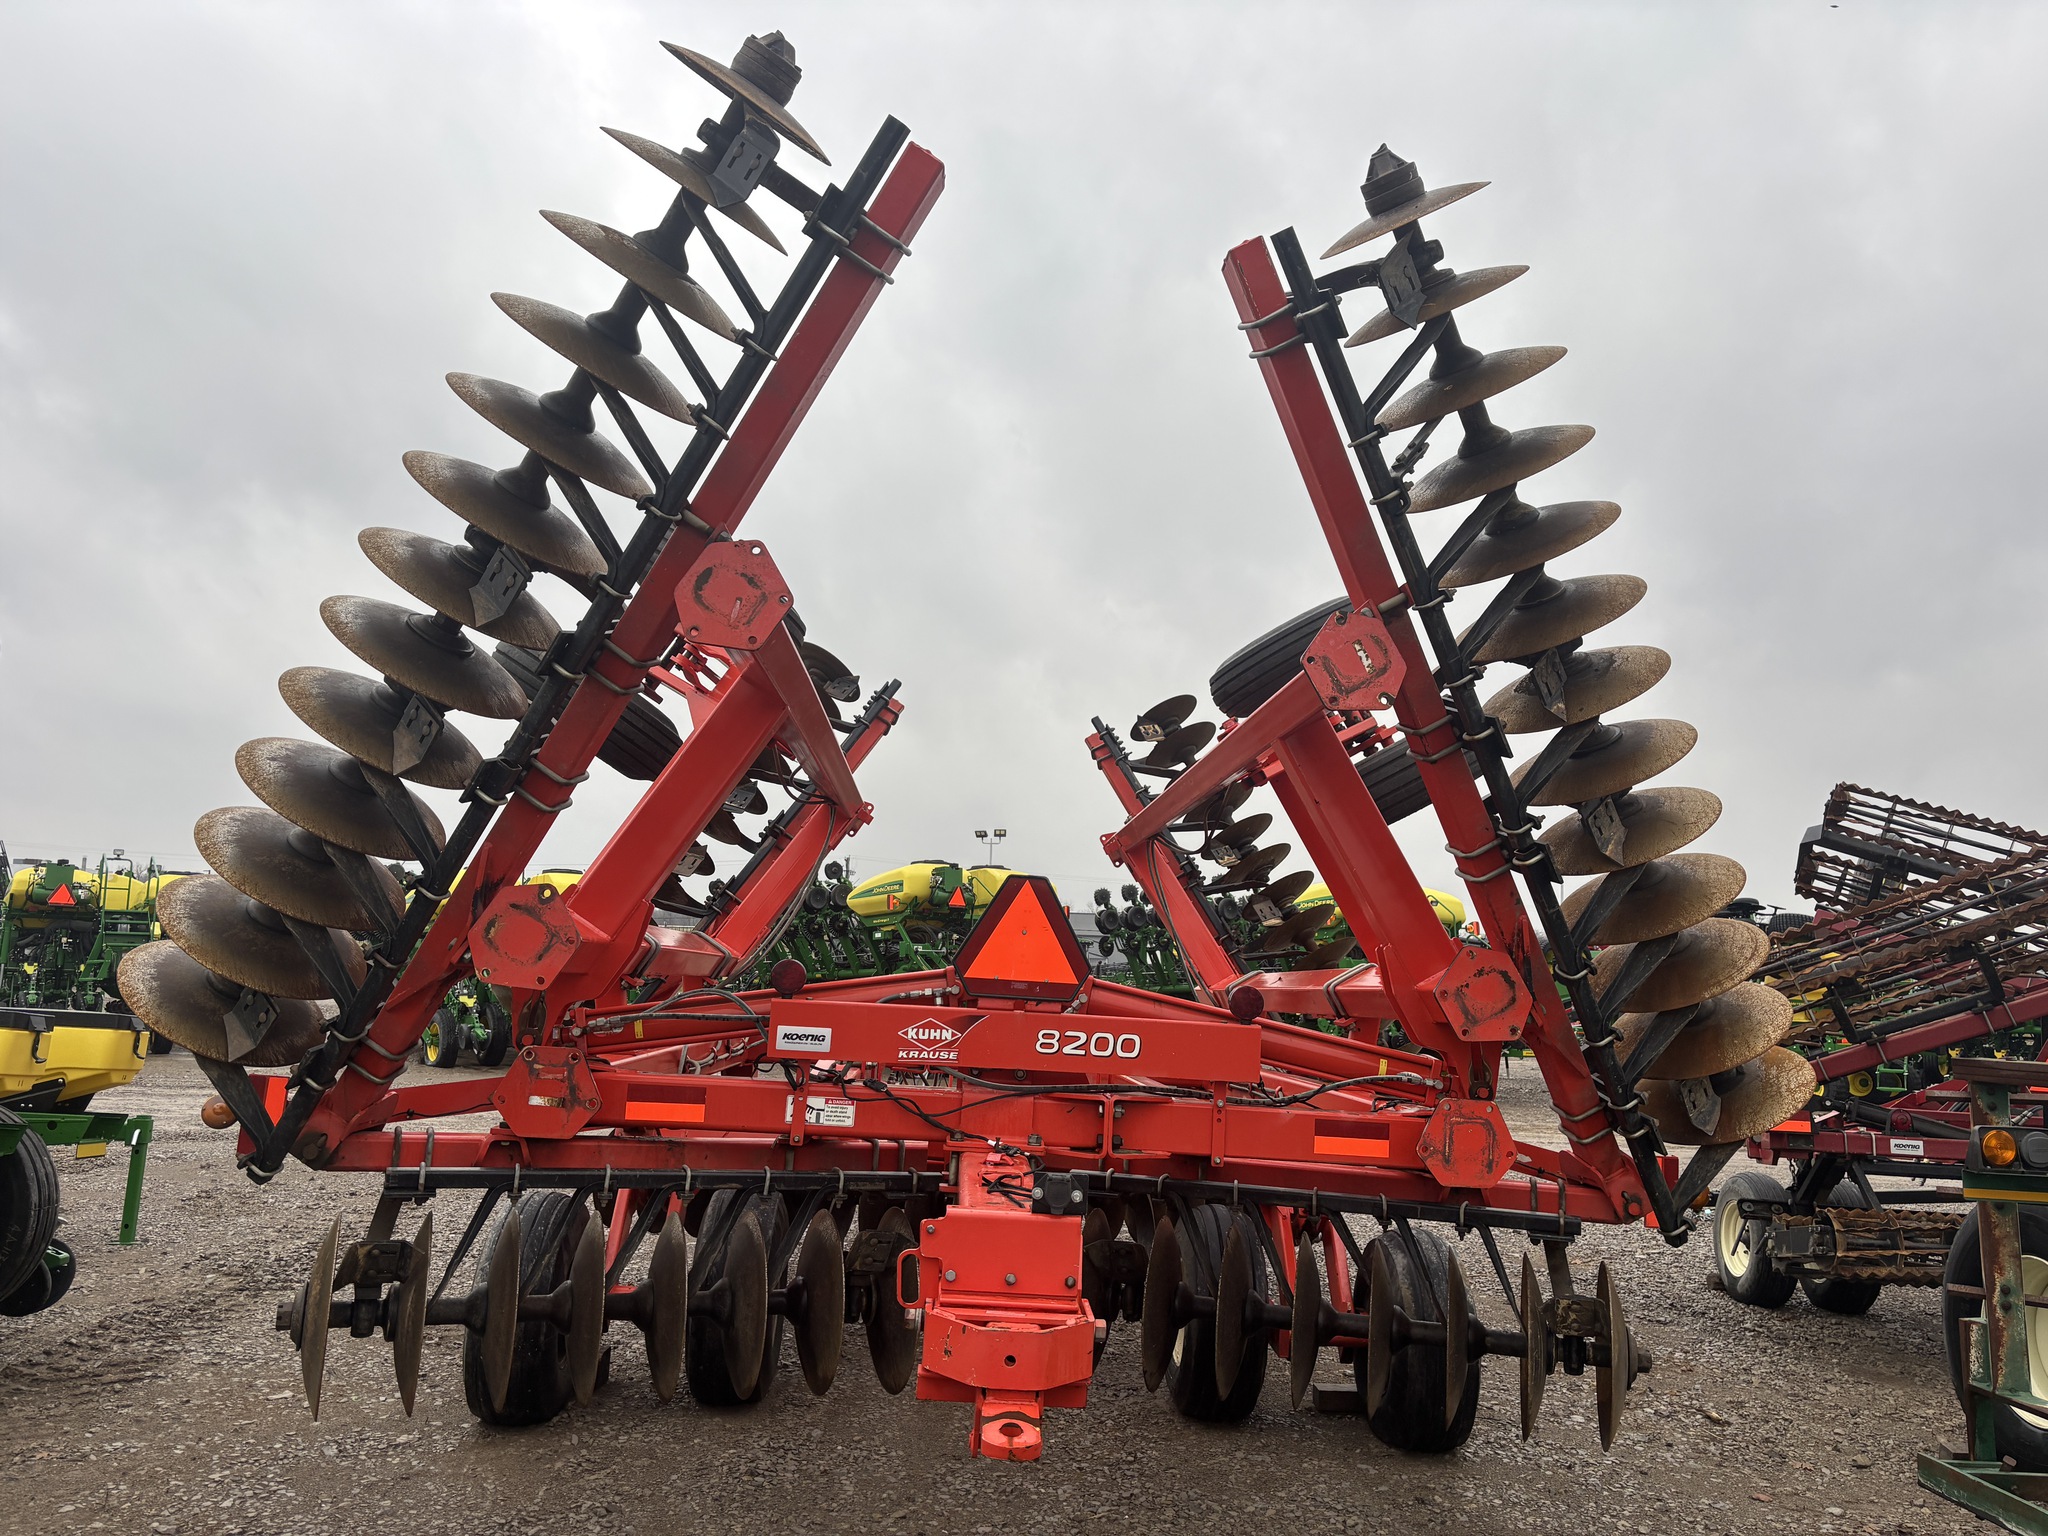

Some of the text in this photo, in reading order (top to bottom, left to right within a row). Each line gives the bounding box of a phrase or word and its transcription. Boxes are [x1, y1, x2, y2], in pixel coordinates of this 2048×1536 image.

[907, 1028, 952, 1041] KUHN
[1035, 1029, 1142, 1059] 8200
[898, 1050, 959, 1060] KRAUSE
